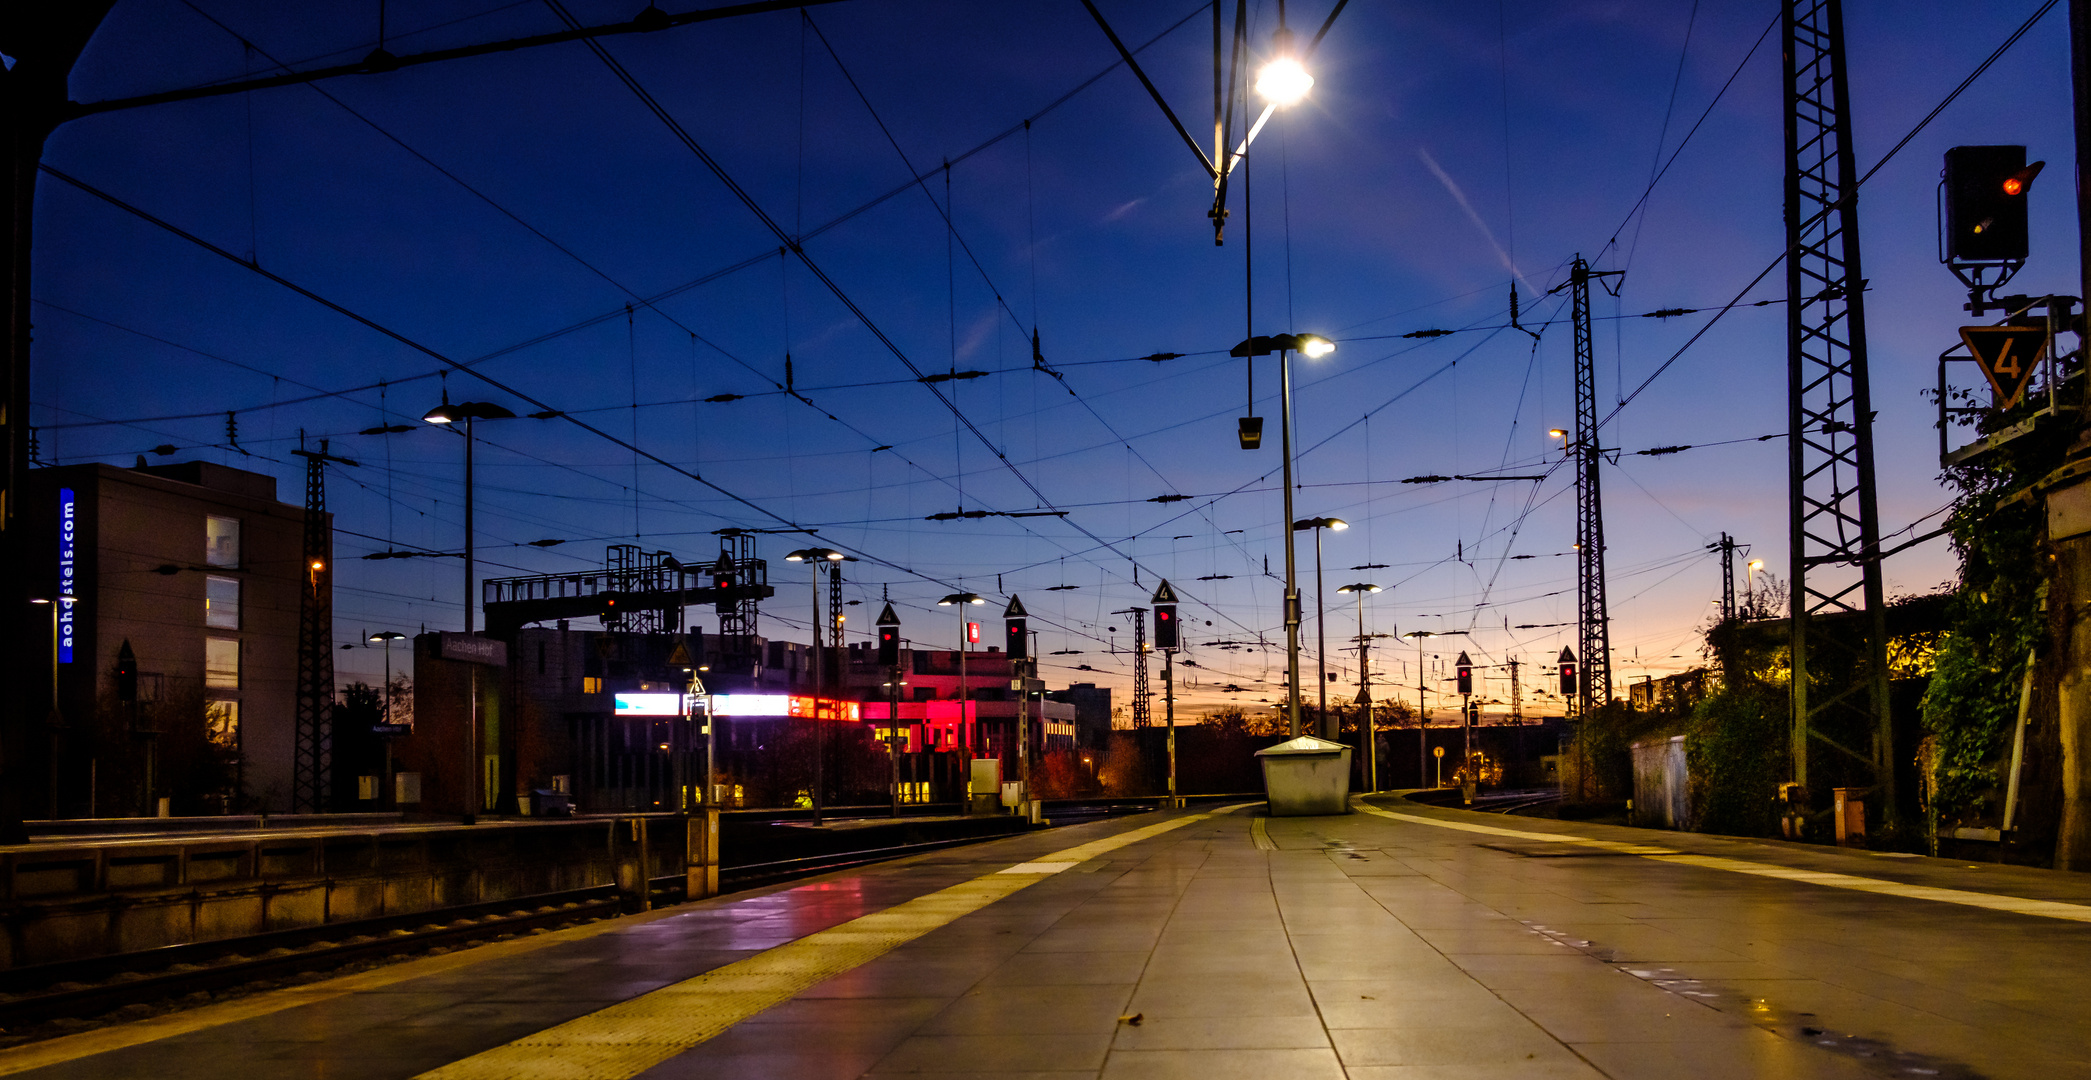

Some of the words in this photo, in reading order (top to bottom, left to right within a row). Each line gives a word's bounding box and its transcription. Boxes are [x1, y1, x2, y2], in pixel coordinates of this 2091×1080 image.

[1994, 338, 2021, 379] 4
[1160, 586, 1168, 600] 4
[1011, 601, 1019, 614] 4
[884, 610, 891, 622] 4
[446, 638, 477, 654] Aachen
[479, 642, 493, 657] Hbf
